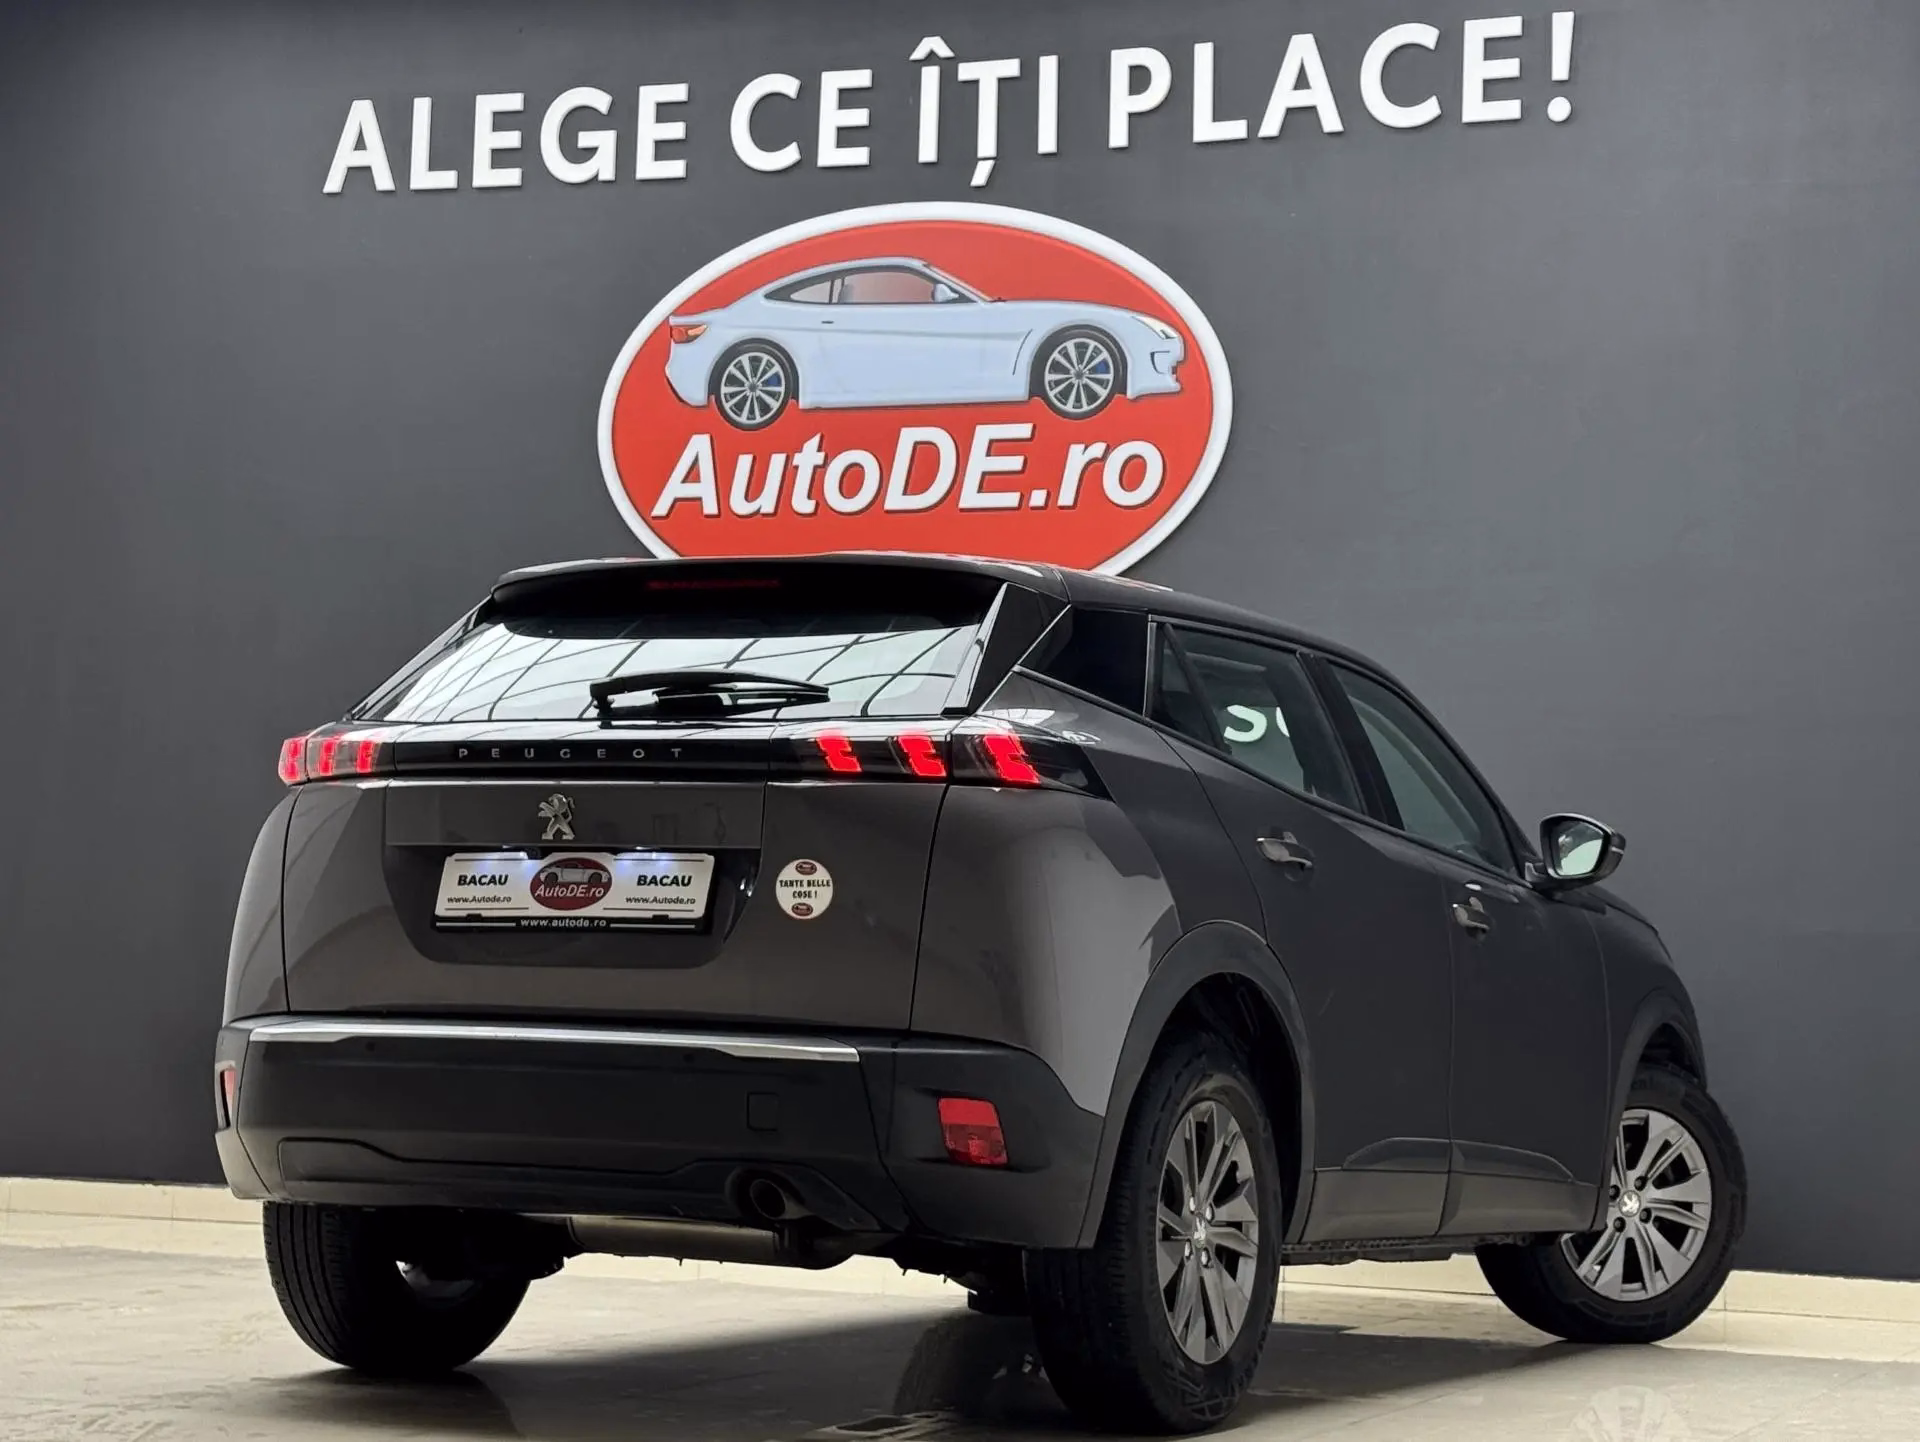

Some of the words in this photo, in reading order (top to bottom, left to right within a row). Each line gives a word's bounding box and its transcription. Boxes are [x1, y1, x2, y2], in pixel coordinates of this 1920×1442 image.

[322, 83, 690, 194] ALEGE
[729, 68, 874, 173] CE
[1108, 10, 1575, 150] PLACE!
[650, 422, 1166, 519] AutoDE.ro
[458, 747, 683, 760] PEUGEOT
[457, 874, 509, 887] BACAU
[636, 874, 693, 888] BACAU
[779, 879, 805, 888] TANTE
[806, 879, 831, 888] BELLE
[534, 884, 605, 898] AutoDE.ro
[520, 917, 607, 928] www.autode.ro
